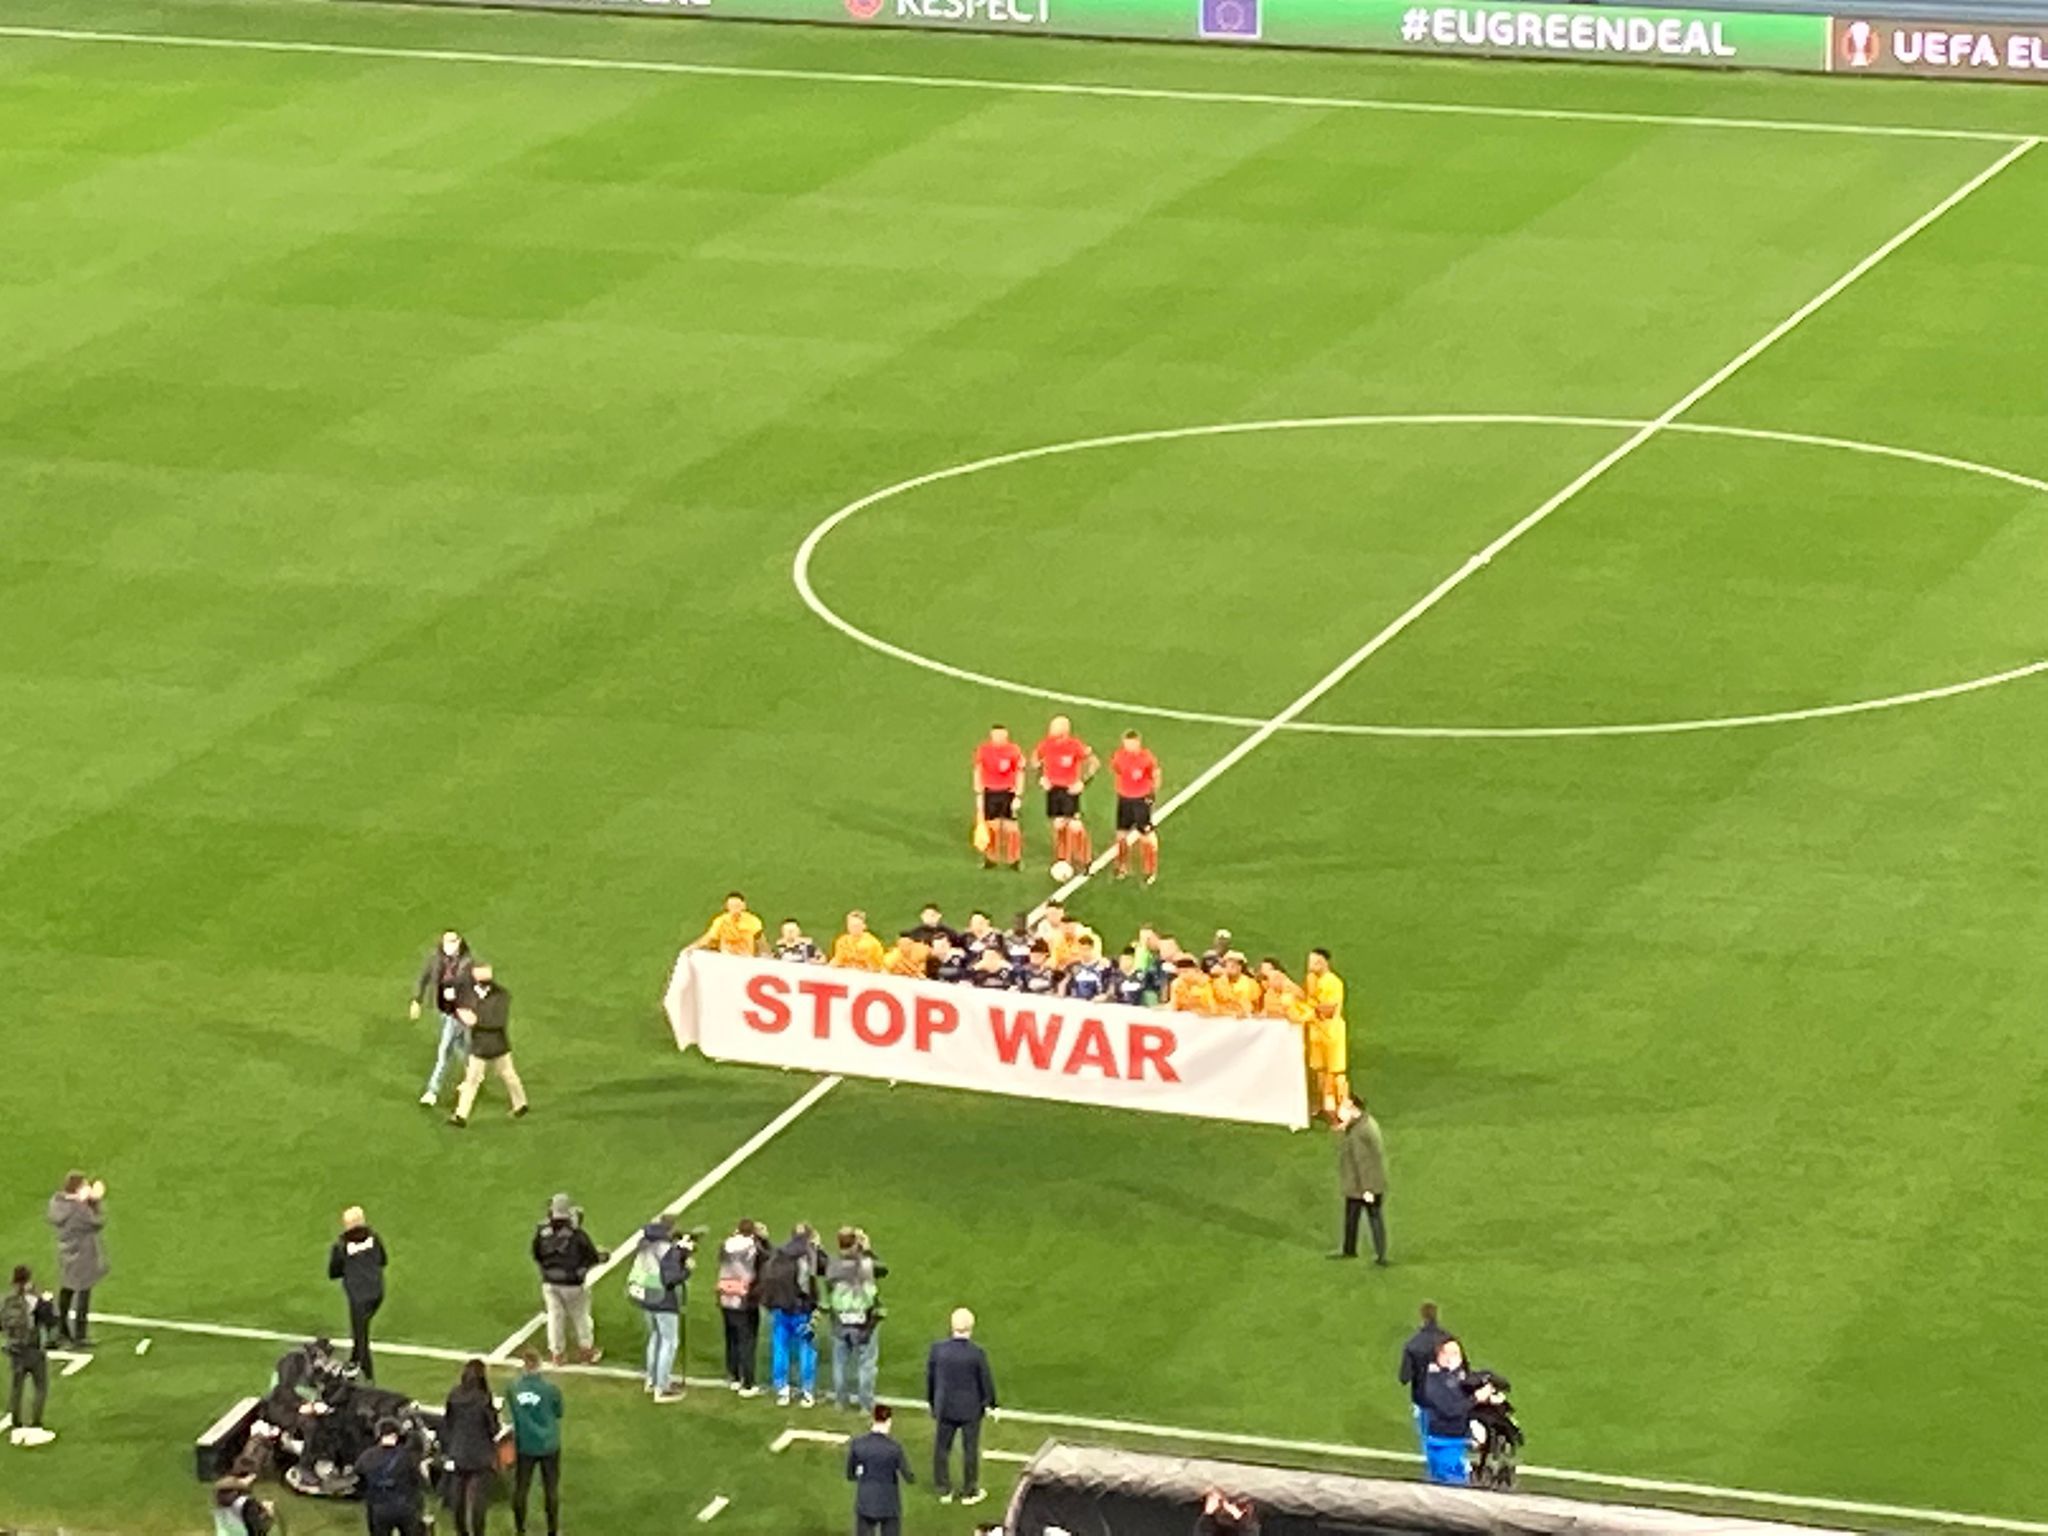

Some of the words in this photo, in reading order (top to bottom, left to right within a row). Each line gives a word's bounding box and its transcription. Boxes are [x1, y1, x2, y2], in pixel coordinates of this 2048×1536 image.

[1401, 8, 1737, 57] #EUGREENDEAL
[1893, 29, 2000, 67] UEFA
[745, 974, 957, 1051] STOP
[989, 1007, 1180, 1082] WAR
